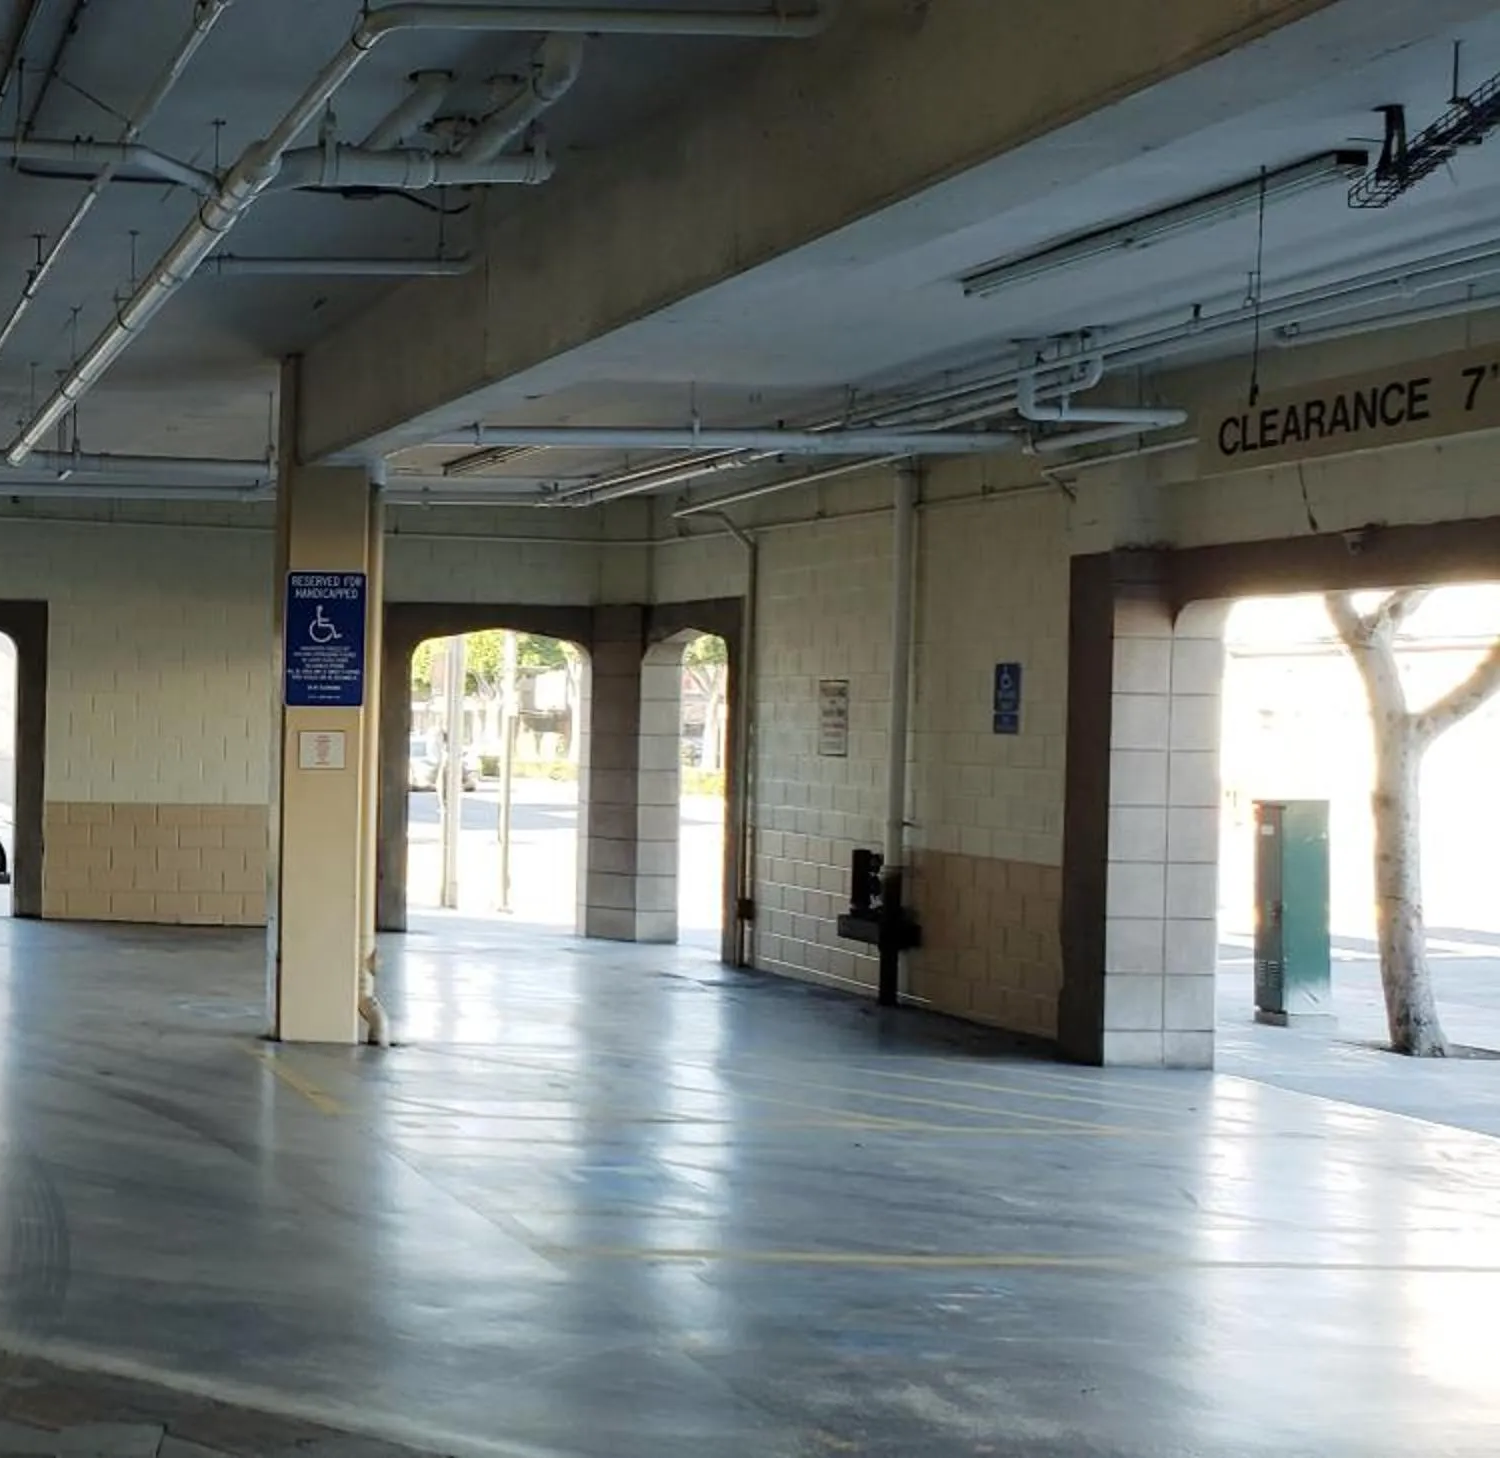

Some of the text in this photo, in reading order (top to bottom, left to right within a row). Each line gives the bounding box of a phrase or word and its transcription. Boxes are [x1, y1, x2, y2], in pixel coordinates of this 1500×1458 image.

[1218, 377, 1431, 455] CLEARANCE
[291, 575, 362, 586] RESERVED FOR
[295, 588, 358, 599] HANDICAPPED
